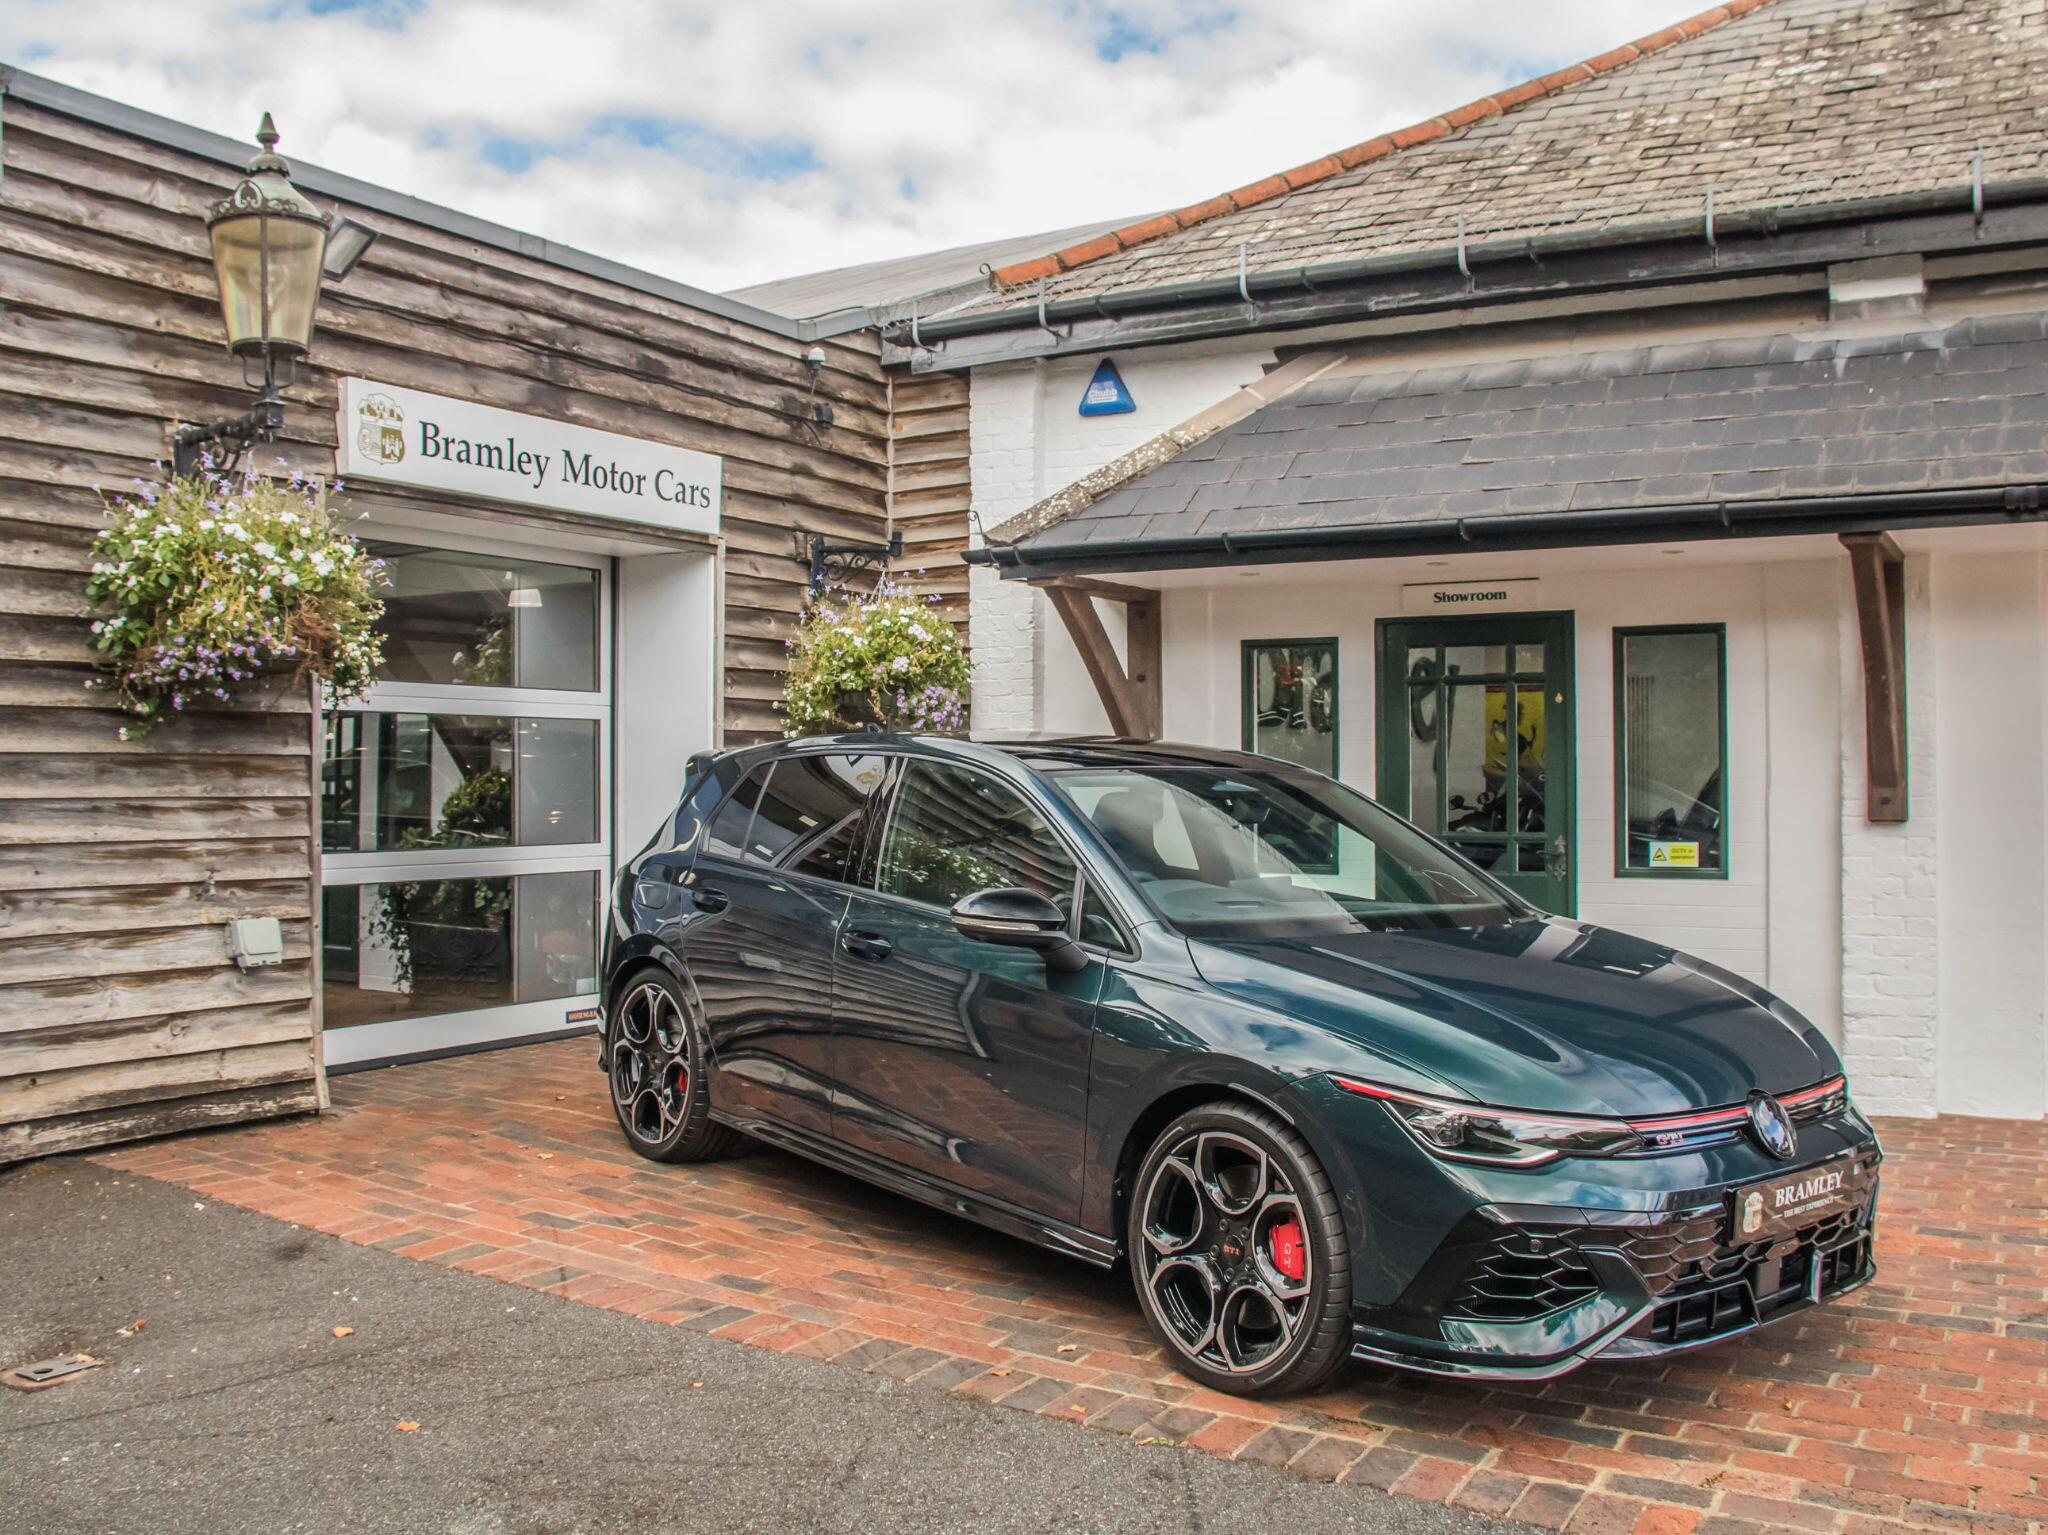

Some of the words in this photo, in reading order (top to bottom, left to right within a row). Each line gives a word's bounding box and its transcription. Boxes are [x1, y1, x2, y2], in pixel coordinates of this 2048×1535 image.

[418, 420, 551, 489] Bramley
[561, 448, 648, 496] Motor
[654, 469, 712, 509] Cars
[1433, 591, 1508, 604] Showroom
[1775, 1170, 1845, 1208] BRAMLEY
